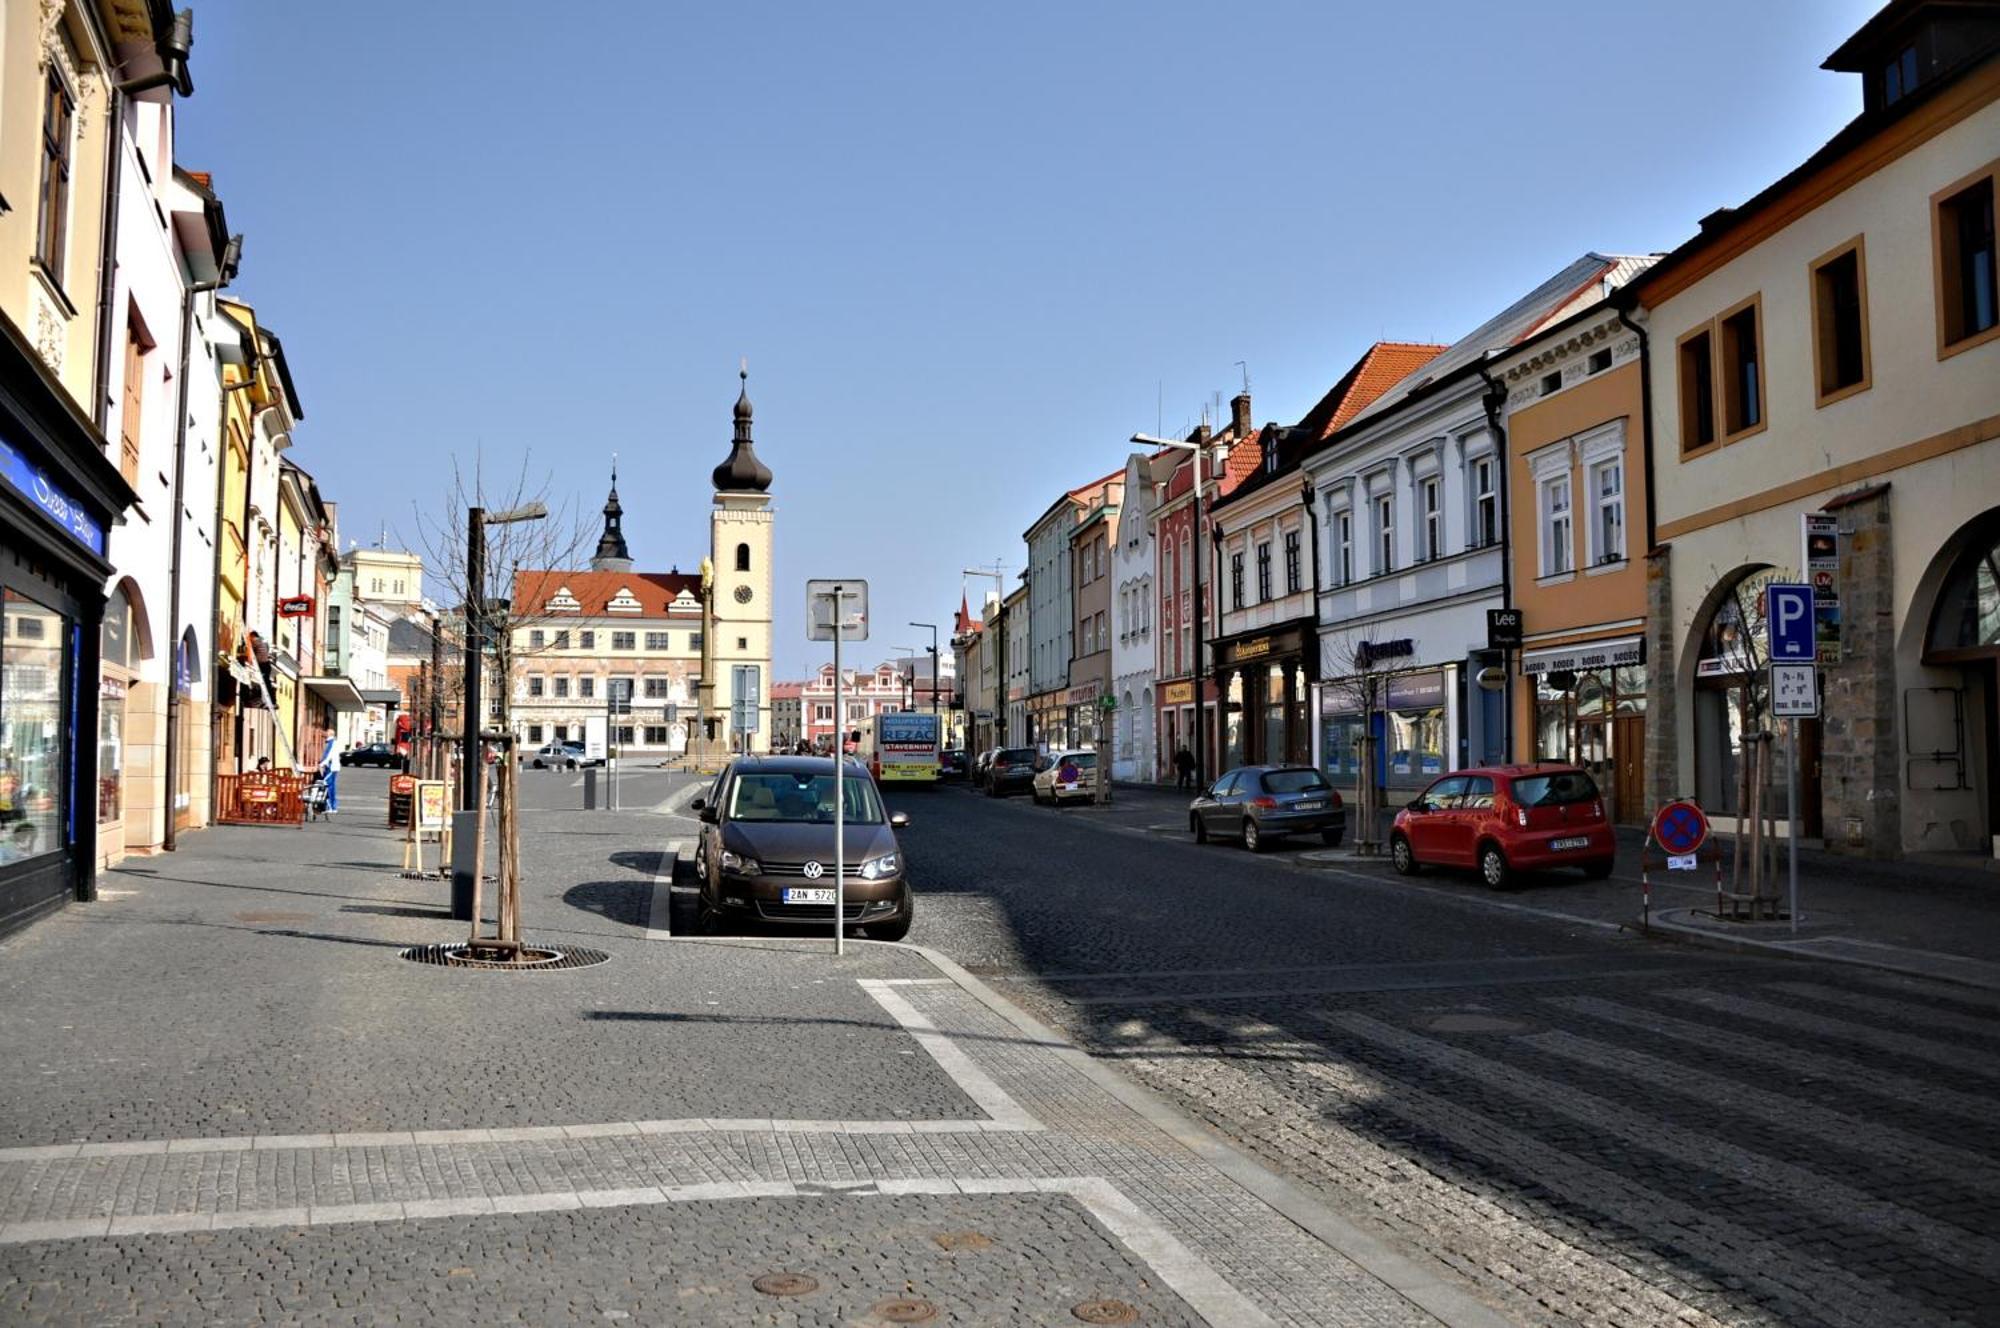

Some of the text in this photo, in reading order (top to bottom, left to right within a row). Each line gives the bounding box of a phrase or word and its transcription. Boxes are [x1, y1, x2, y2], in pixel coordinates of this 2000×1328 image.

[1494, 612, 1516, 625] Lee
[1778, 594, 1804, 636] P
[1553, 659, 1575, 669] RODEO
[1582, 655, 1606, 666] RODEO
[791, 890, 808, 900] 2AN
